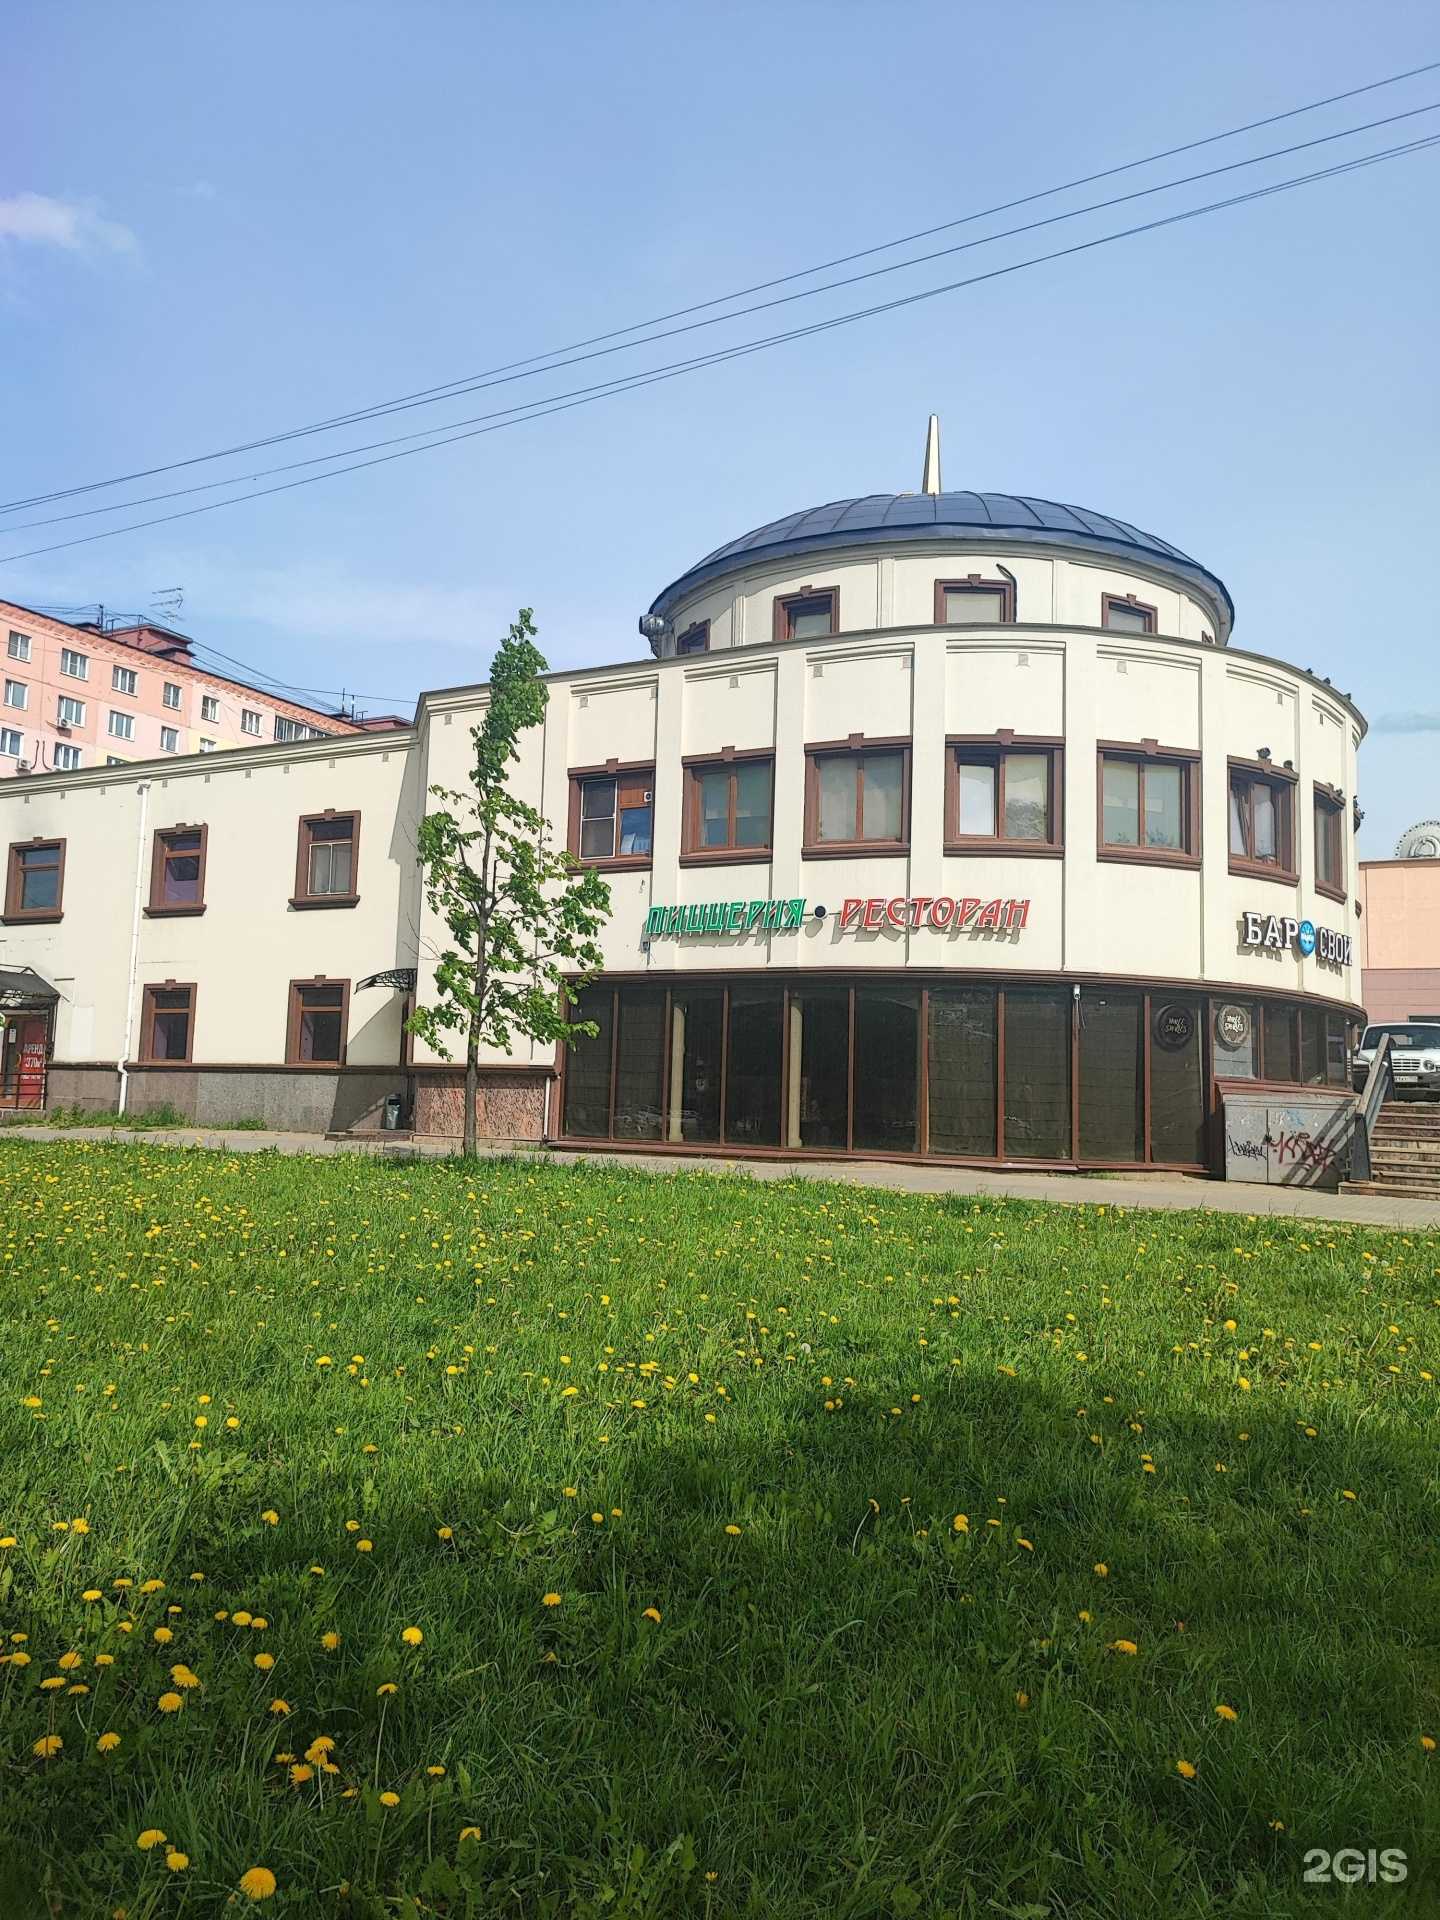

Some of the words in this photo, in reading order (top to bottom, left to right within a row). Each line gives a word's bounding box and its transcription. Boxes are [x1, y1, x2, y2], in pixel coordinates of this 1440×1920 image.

[645, 898, 806, 935] ПИЦЦЕРИЯ
[839, 897, 1031, 928] РЕСТОРАН
[1243, 912, 1299, 950] БАР
